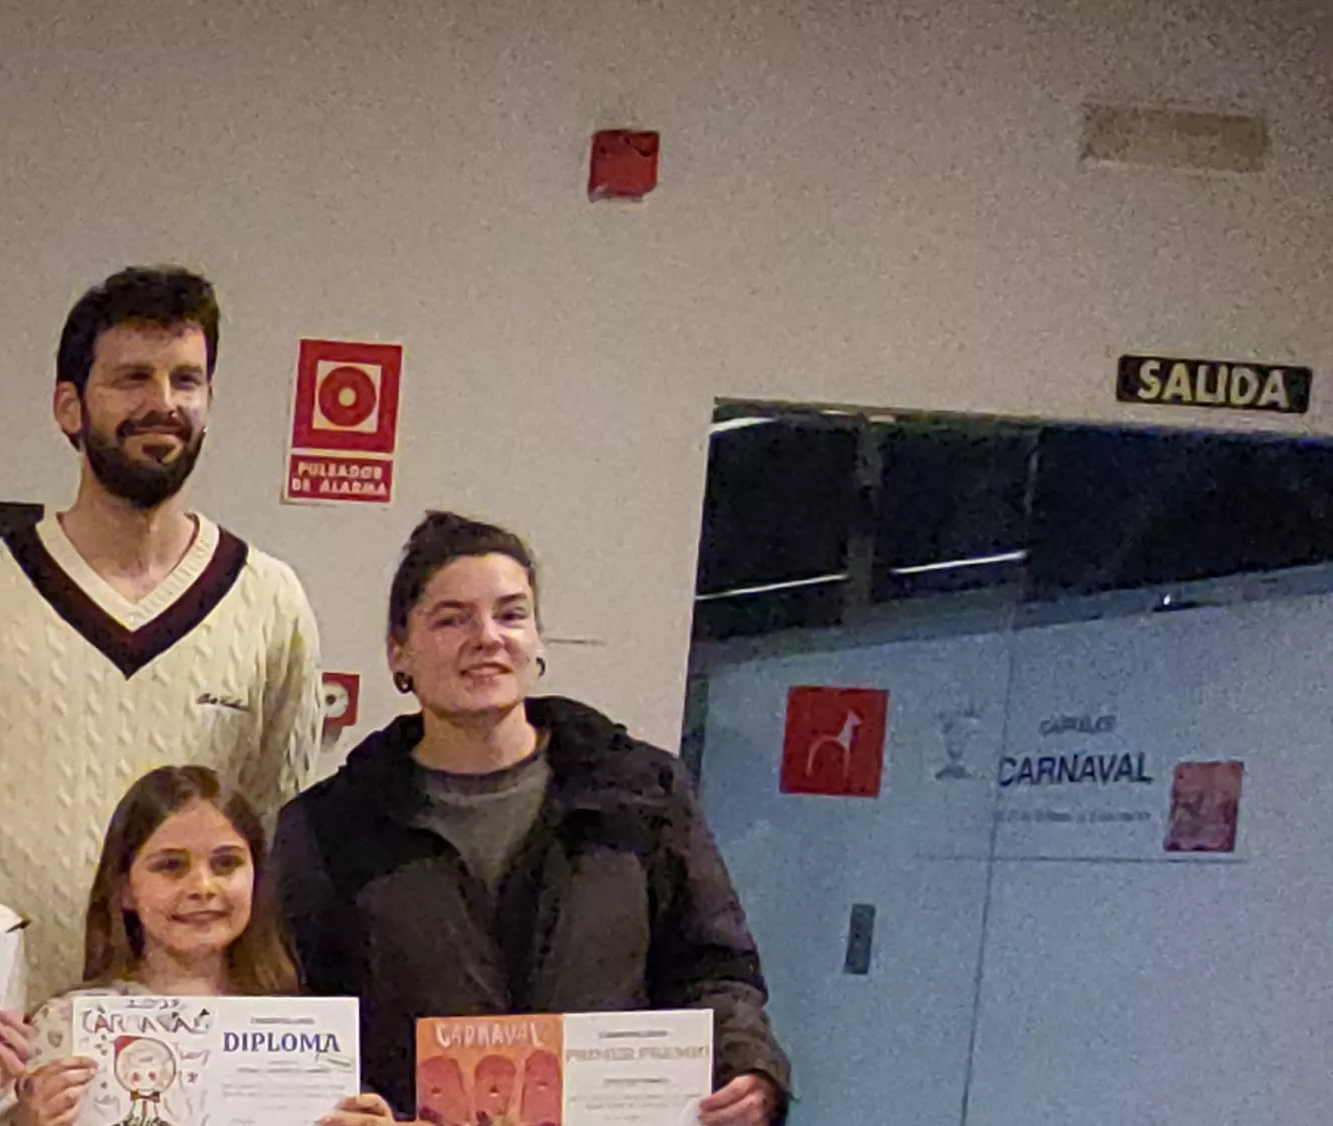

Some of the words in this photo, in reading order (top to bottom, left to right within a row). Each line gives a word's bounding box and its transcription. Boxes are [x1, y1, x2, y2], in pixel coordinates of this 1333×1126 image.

[1137, 360, 1290, 409] SALIDA
[297, 461, 383, 479] PULSADOR
[291, 478, 311, 492] DE
[319, 479, 387, 496] ALARMA
[997, 751, 1154, 787] CARNAVAL
[223, 1031, 341, 1054] DIPLOMA
